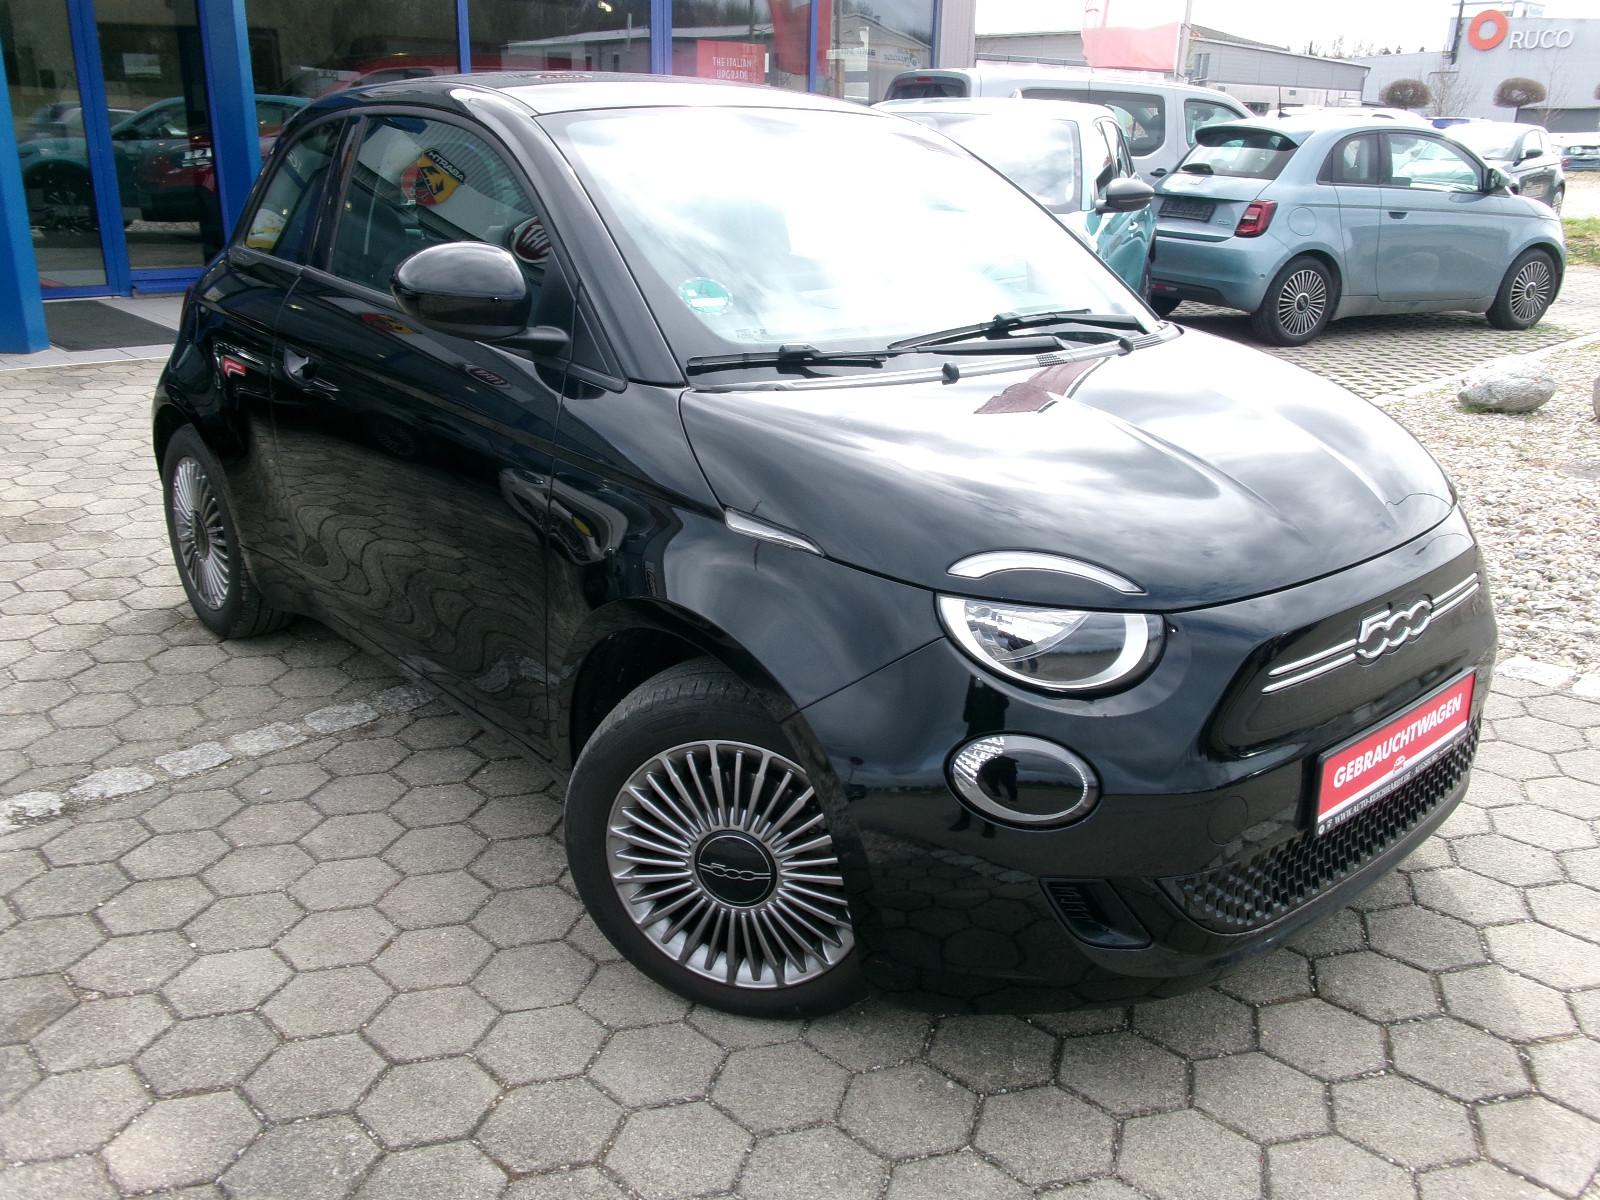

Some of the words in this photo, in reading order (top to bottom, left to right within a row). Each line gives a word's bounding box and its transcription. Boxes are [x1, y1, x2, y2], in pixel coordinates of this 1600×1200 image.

[1508, 28, 1574, 50] RUCO
[712, 57, 726, 67] THE
[727, 58, 752, 68] ITALIAN
[716, 70, 749, 80] UPGRADE
[1357, 599, 1433, 659] 500
[1333, 693, 1462, 788] GEBRAUCHTWAGEN
